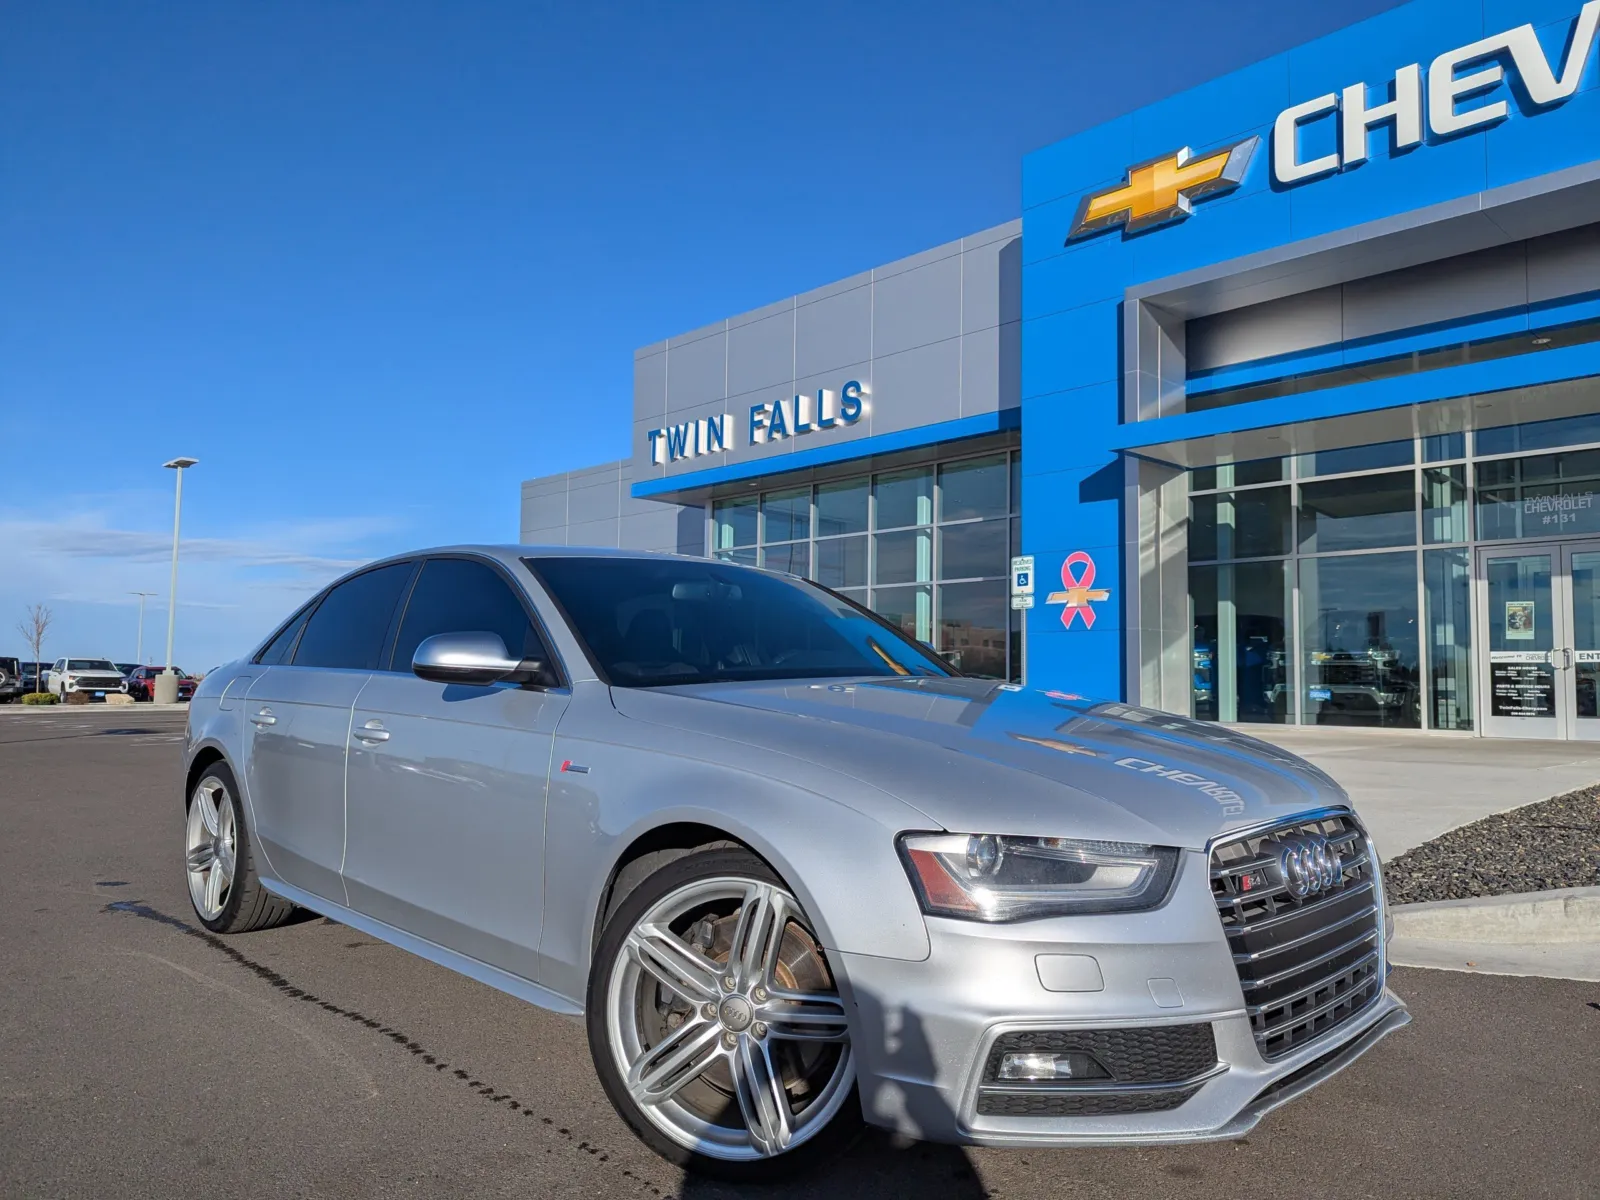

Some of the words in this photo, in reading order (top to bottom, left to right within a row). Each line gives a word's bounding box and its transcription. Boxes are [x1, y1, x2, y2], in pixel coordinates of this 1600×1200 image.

[1274, 0, 1600, 183] CHEV
[648, 413, 734, 467] TWIN
[749, 380, 869, 447] FALLS
[1524, 497, 1593, 514] CHEVROLET
[1542, 513, 1576, 525] #131
